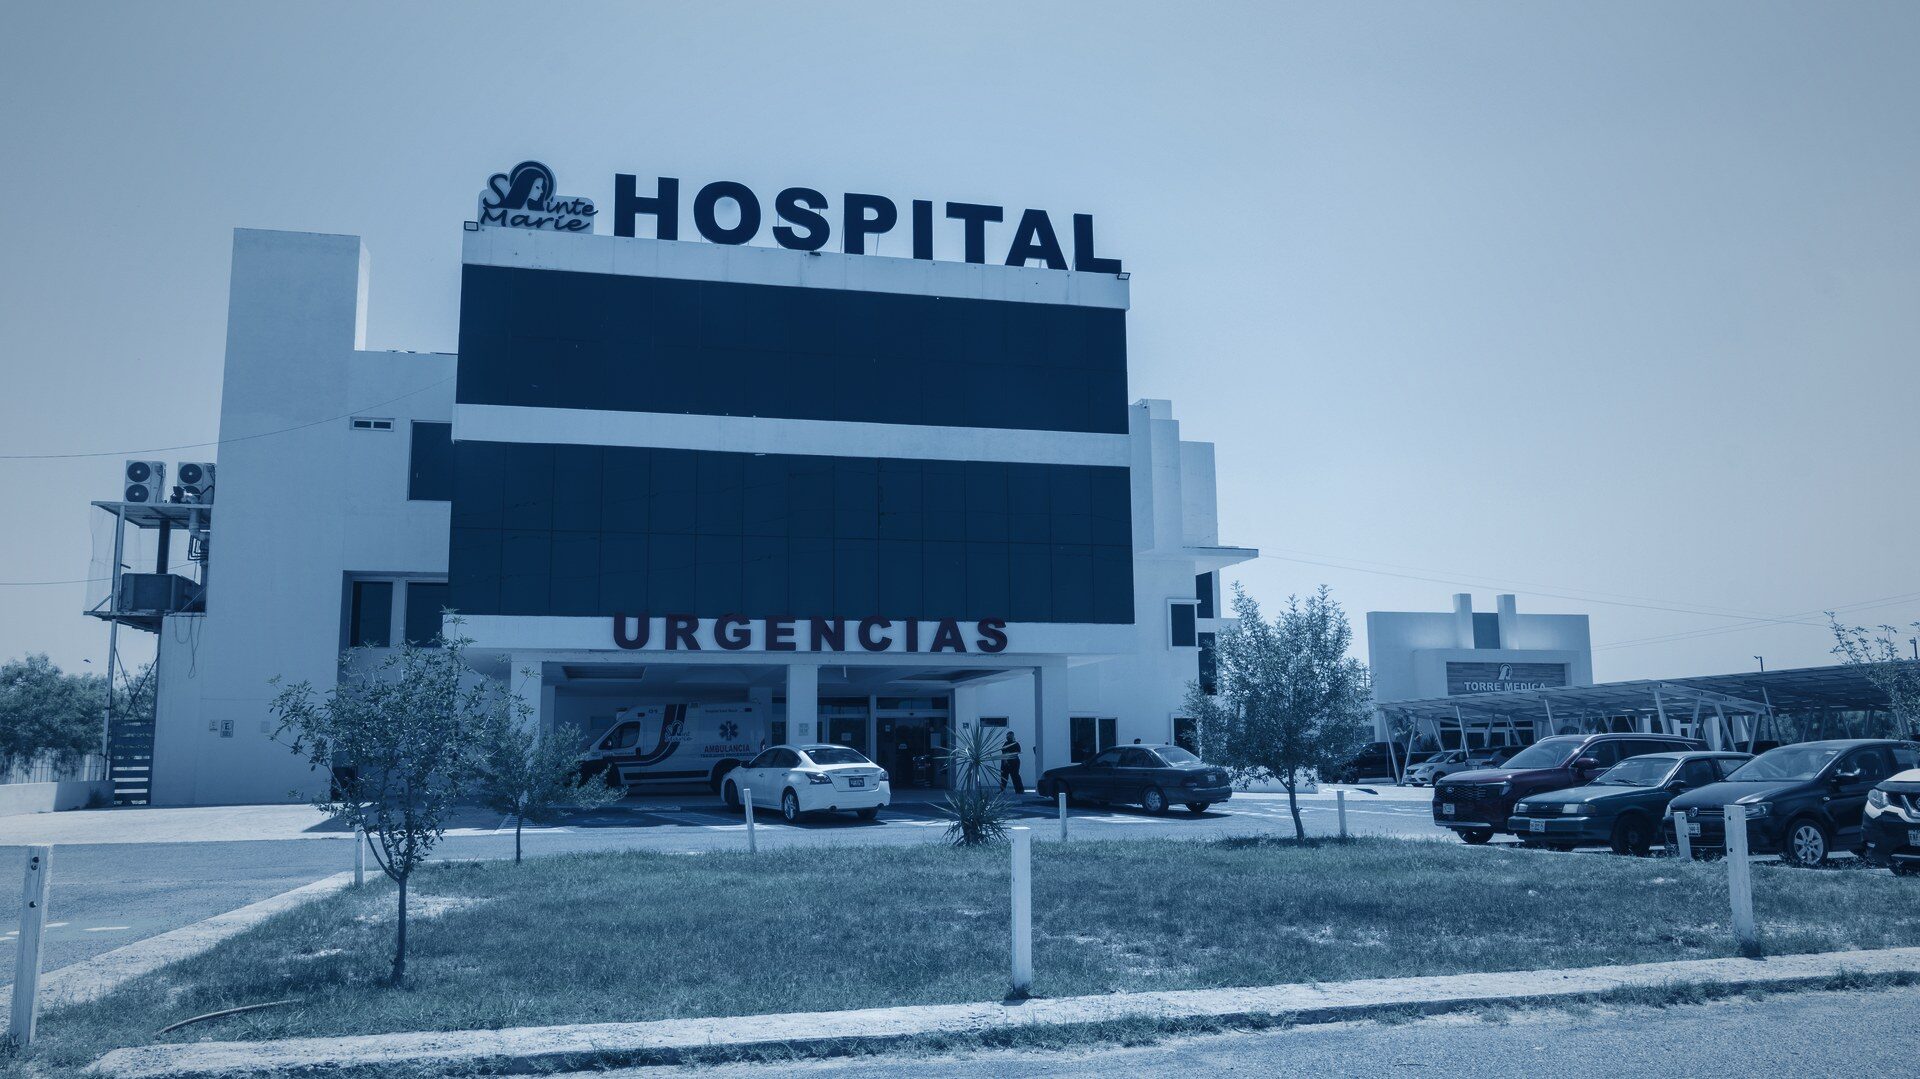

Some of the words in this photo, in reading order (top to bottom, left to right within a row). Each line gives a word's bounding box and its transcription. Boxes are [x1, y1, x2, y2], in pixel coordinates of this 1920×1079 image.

[480, 207, 590, 232] Marie
[614, 173, 1122, 274] HOSPITAL
[613, 613, 1009, 654] URGENCIAS
[1464, 681, 1501, 692] TORRE
[704, 744, 751, 753] AMBULANCIA
